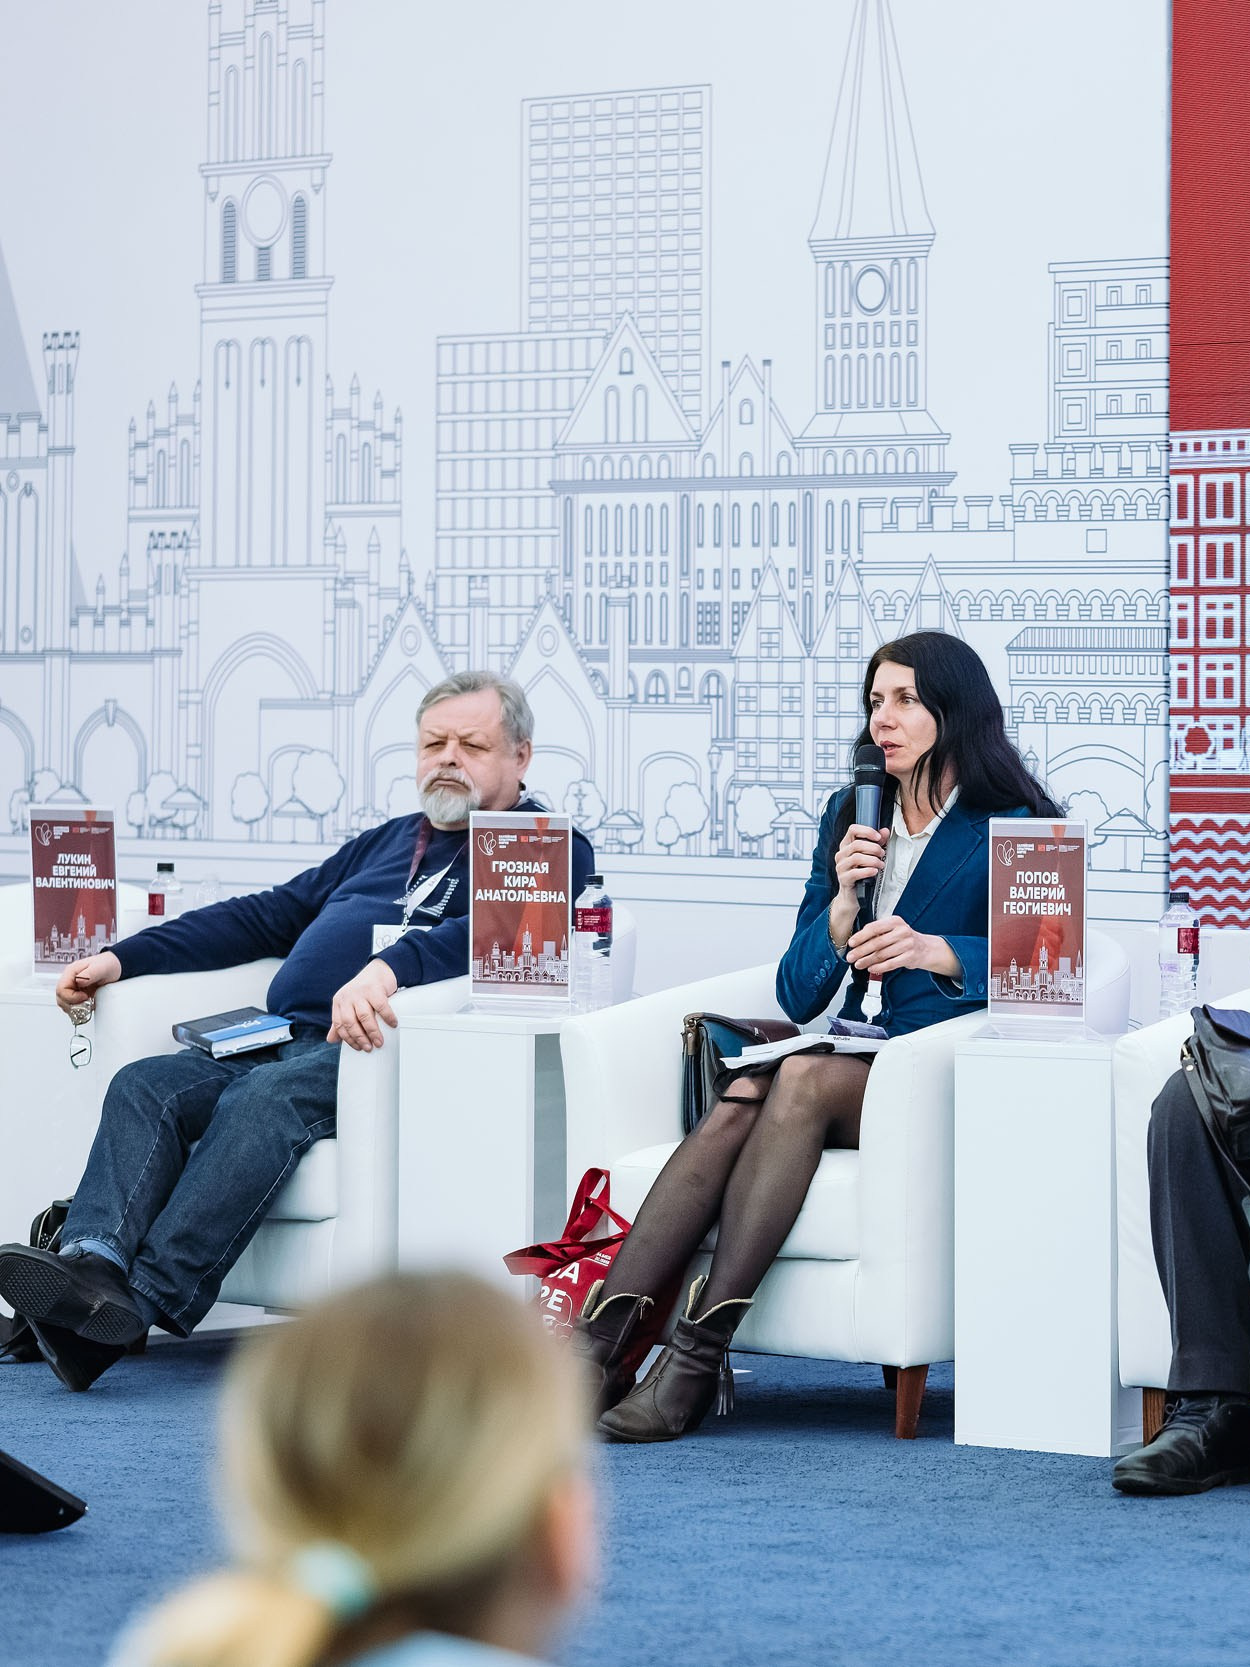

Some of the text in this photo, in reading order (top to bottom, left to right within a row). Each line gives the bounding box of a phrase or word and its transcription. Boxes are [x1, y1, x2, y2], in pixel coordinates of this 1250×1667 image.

[57, 853, 91, 865] ЛУКИН
[52, 864, 97, 877] ЕВГЕНИЙ
[491, 861, 549, 874] ГРОЗНАЯ
[35, 877, 115, 890] ВАЛЕНТИНОВИЧ
[504, 875, 537, 888] КИРА
[1016, 871, 1059, 885] ПОПОВ
[475, 889, 566, 903] АНАТОЛЬЕВНА
[1009, 884, 1065, 900] ВАЛЕРИЙ
[1003, 901, 1071, 916] ГЕОГИЕВИЧ
